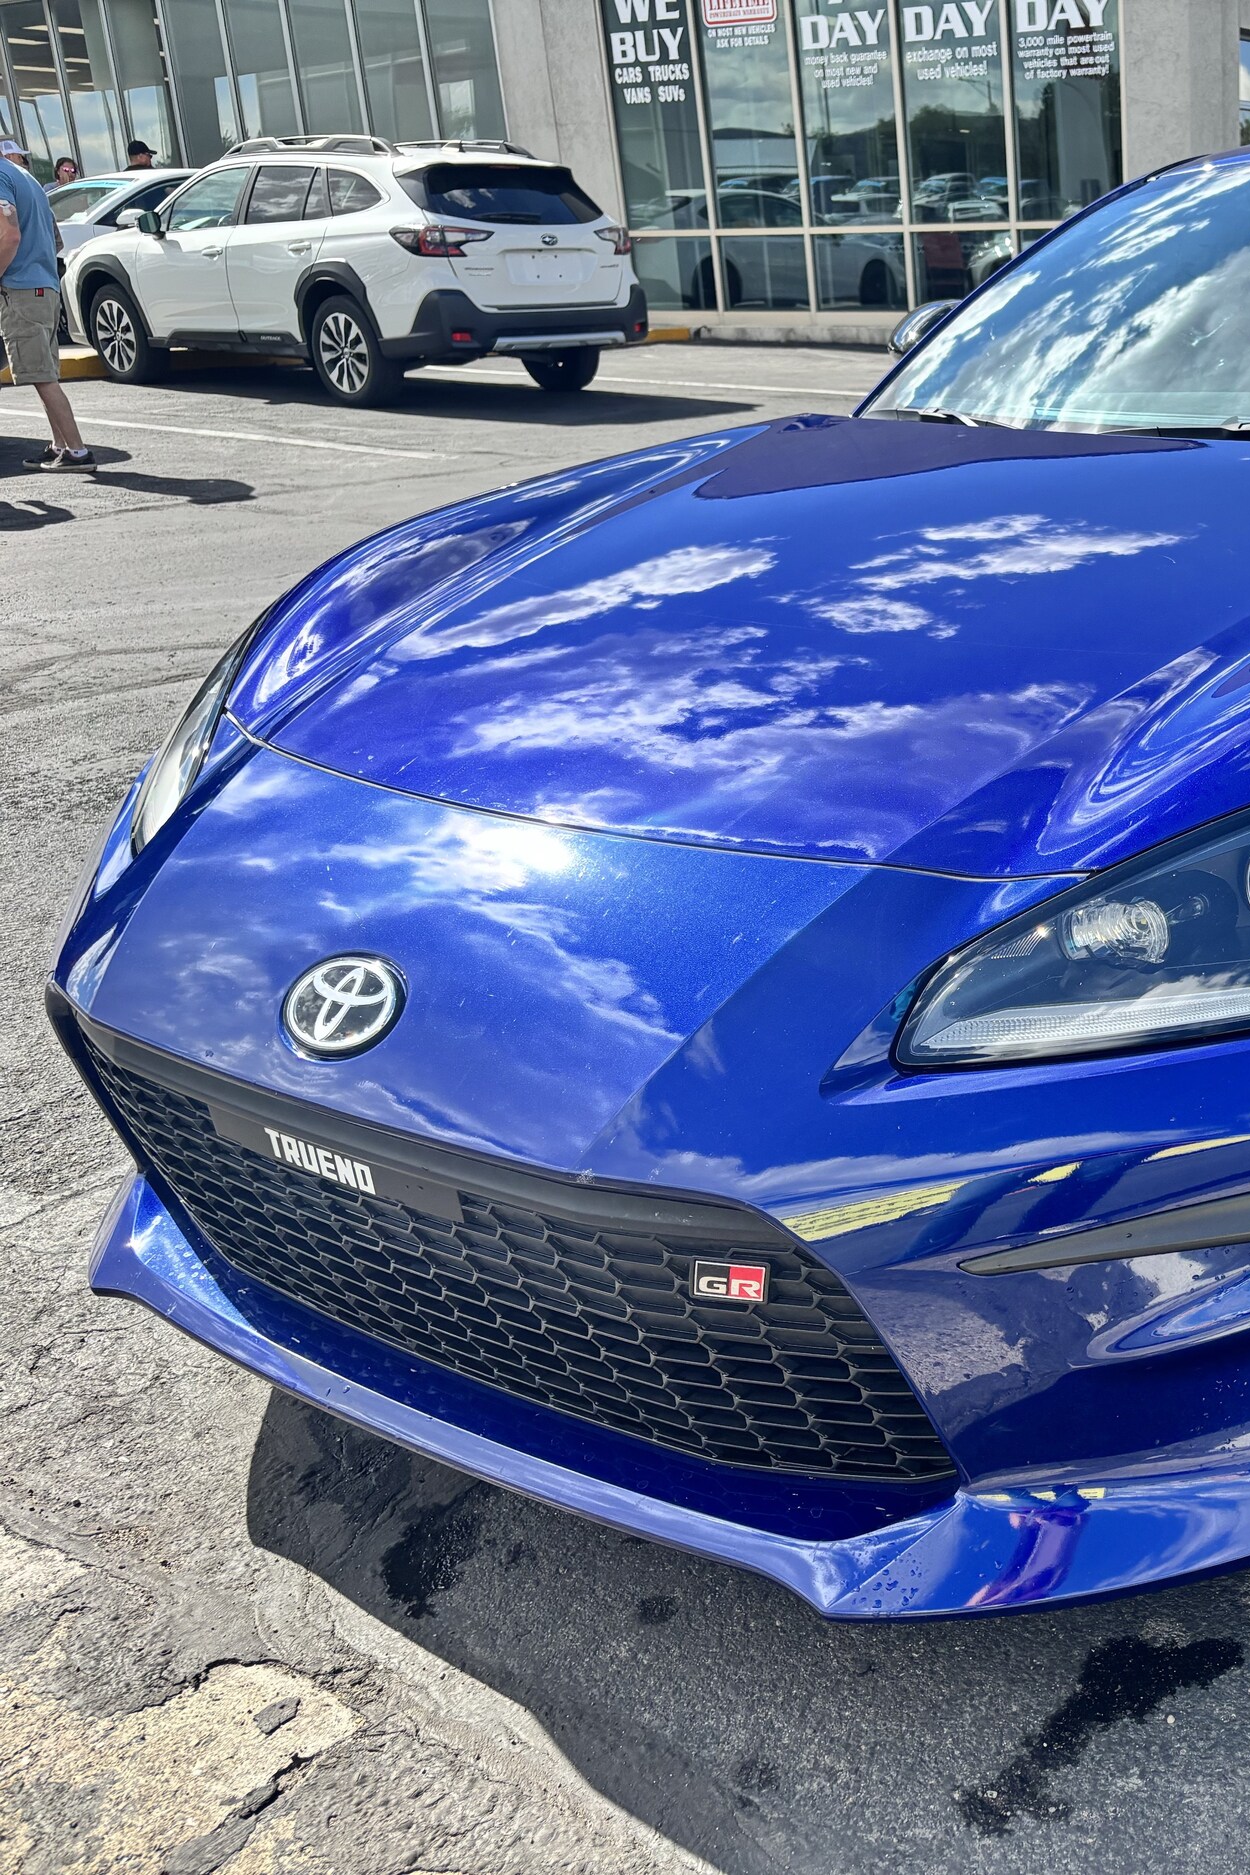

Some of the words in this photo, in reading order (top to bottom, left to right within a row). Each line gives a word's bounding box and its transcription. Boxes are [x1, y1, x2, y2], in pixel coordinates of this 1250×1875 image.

[614, 0, 680, 24] WE
[902, 0, 995, 42] DAY
[1015, 0, 1108, 33] DAY
[717, 26, 733, 37] MOST
[734, 26, 747, 36] NEW
[748, 23, 776, 35] VEHICLES
[800, 9, 886, 50] DAY
[610, 27, 684, 64] BUY
[716, 38, 730, 49] ASK
[730, 37, 743, 47] FOR
[744, 35, 769, 46] DETAILS
[1017, 47, 1054, 58] warranty
[1054, 47, 1066, 56] on
[1067, 44, 1090, 55] most
[1092, 41, 1115, 52] used
[1018, 36, 1045, 49] 3,000
[1046, 35, 1065, 45] mile
[1066, 31, 1113, 45] powertrain
[804, 55, 829, 66] money
[829, 51, 849, 63] back
[849, 49, 888, 65] guarantee
[905, 46, 953, 64] exchange
[954, 46, 969, 59] on
[971, 41, 998, 58] most
[1023, 57, 1058, 69] vehicles
[1059, 55, 1078, 66] that
[1079, 56, 1095, 65] are
[1094, 53, 1110, 64] out
[614, 66, 643, 84] CARS
[647, 62, 690, 82] TRUCKS
[813, 69, 825, 78] on
[825, 65, 845, 77] most
[845, 66, 862, 76] new
[863, 62, 879, 75] and
[917, 63, 942, 80] used
[943, 60, 988, 78] vehicles!
[1024, 69, 1034, 80] of
[1036, 67, 1068, 79] factory
[1068, 63, 1110, 77] warranty!
[821, 77, 841, 88] used
[840, 73, 874, 87] vehicles!
[622, 86, 652, 104] VANS
[657, 84, 686, 103] SUVs
[264, 1127, 376, 1196] TRUENO
[698, 1276, 761, 1298] GR
